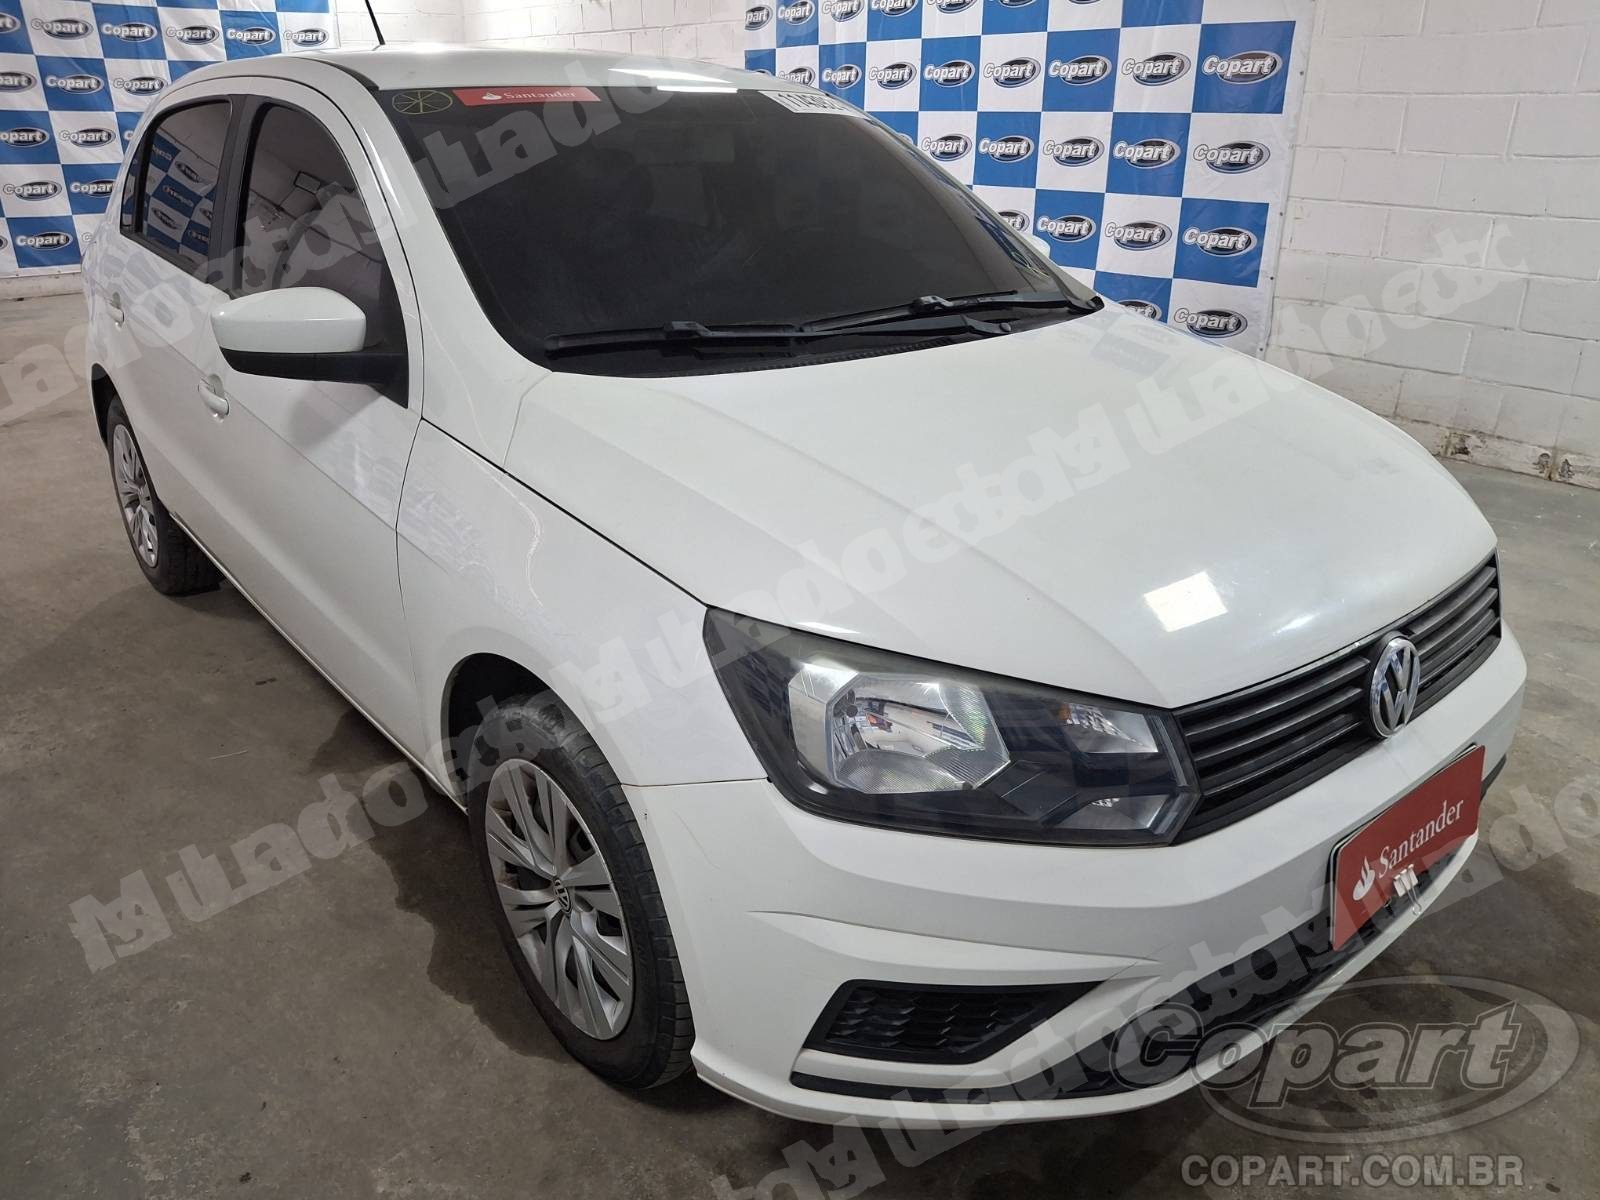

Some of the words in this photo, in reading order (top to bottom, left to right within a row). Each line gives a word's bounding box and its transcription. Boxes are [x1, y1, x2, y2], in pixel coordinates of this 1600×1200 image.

[745, 9, 768, 26] part
[778, 6, 810, 22] Copart
[822, 0, 858, 17] Copart
[31, 18, 85, 35] Copart
[101, 23, 150, 38] Copart
[166, 27, 212, 42] Copart
[226, 28, 270, 42] Copart
[284, 29, 324, 42] Copart
[924, 61, 968, 82] Copart
[984, 60, 1033, 81] Copart
[1048, 58, 1103, 80] Copart
[1121, 56, 1181, 79] Copart
[1202, 53, 1273, 78] Copart
[46, 76, 97, 91] Copart
[113, 77, 160, 91] Copart
[822, 68, 856, 86] Copart
[868, 66, 910, 84] Copart
[503, 91, 578, 100] Santander
[0, 131, 44, 145] opart
[59, 130, 108, 145] Copart
[921, 136, 966, 157] Copart
[979, 138, 1030, 159] Copart
[1043, 139, 1097, 161] Copart
[1113, 141, 1173, 164] Copart
[1193, 144, 1260, 167] Copart
[2, 182, 53, 197] Copart
[71, 181, 115, 197] Copar
[1036, 216, 1091, 238] Copart
[1104, 221, 1164, 245] Copart
[15, 232, 67, 248] Copart
[1182, 226, 1252, 251] Copart
[1173, 307, 1239, 333] Copart
[1379, 799, 1464, 879] Santander
